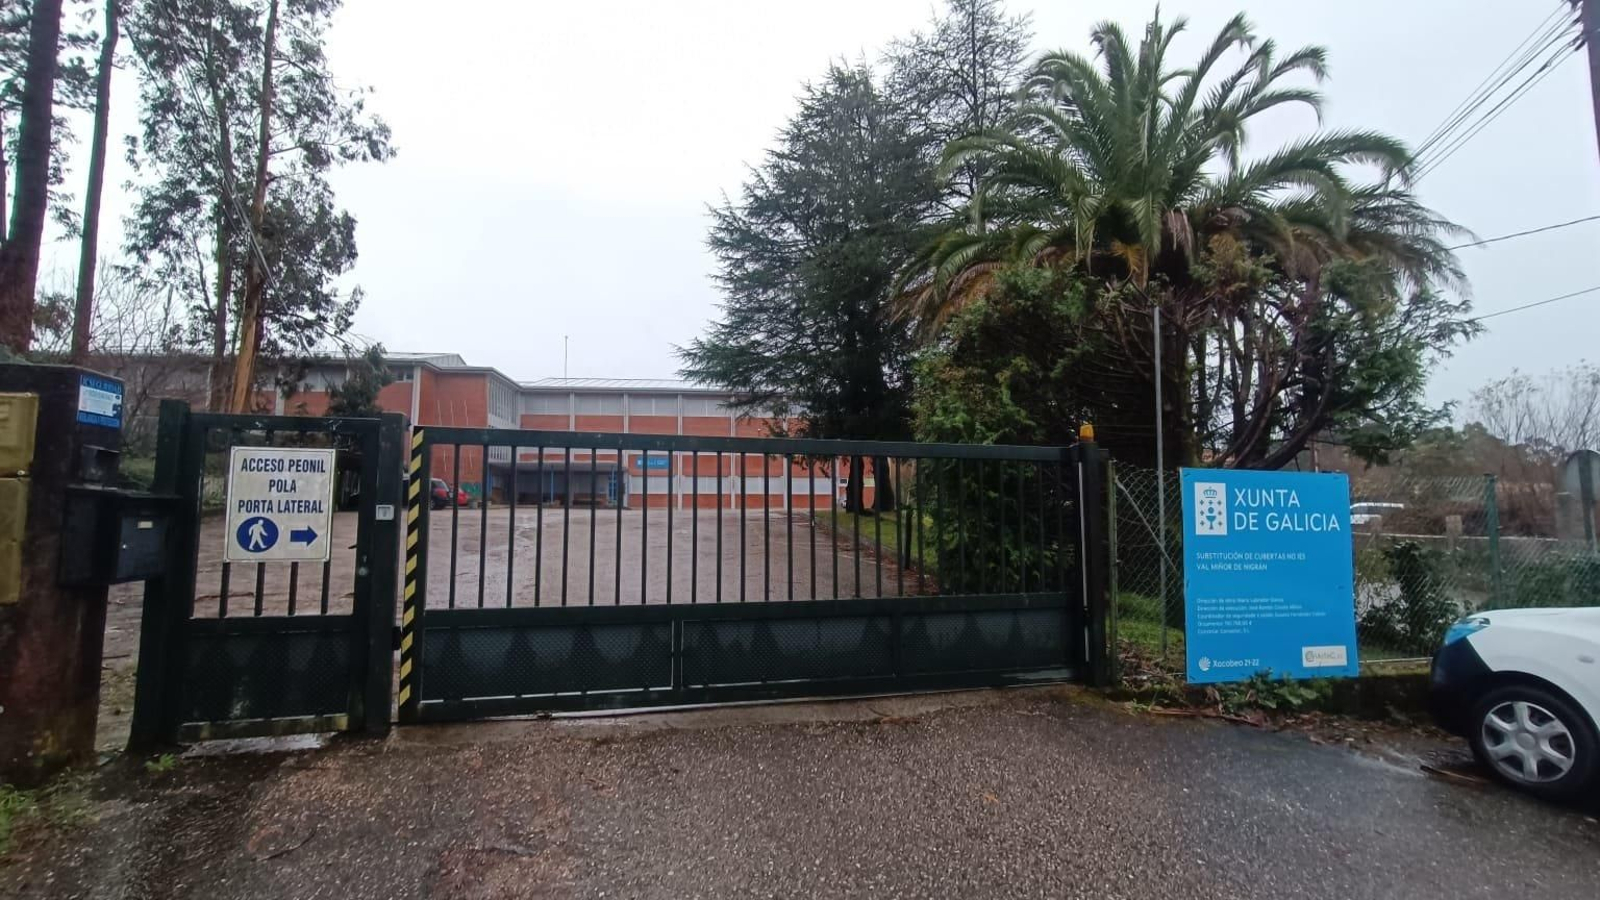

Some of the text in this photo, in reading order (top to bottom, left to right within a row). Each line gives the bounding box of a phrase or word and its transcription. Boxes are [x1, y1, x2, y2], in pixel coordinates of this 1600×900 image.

[241, 458, 326, 473] ACCESO PEONIL
[268, 479, 297, 493] POLA
[1234, 488, 1300, 507] XUNTA
[238, 499, 324, 514] PORTA LATERAL
[1234, 512, 1341, 531] DE GALICIA
[1196, 551, 1243, 560] SUBSTITUCIÓN
[1244, 552, 1253, 560] DE
[1197, 562, 1267, 571] VAL MIÑOR DE NIGRÁN
[1244, 658, 1259, 666] 21-22
